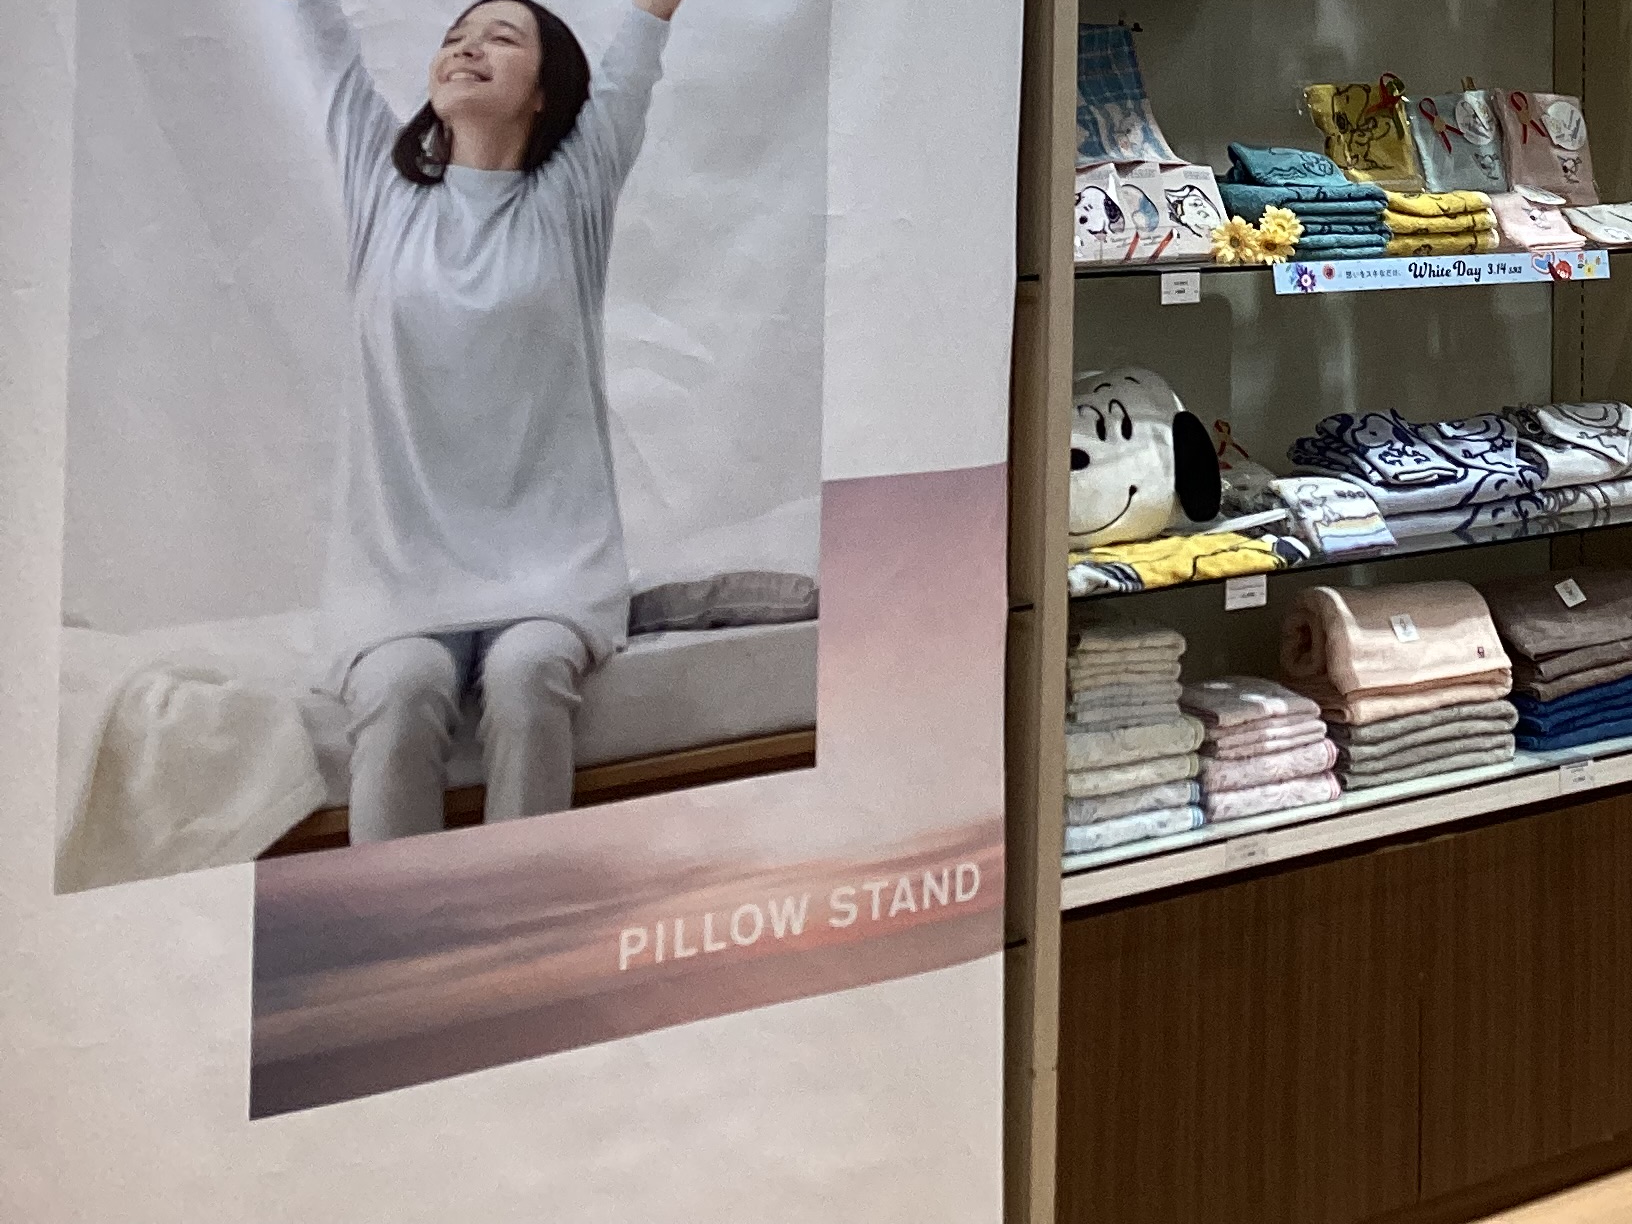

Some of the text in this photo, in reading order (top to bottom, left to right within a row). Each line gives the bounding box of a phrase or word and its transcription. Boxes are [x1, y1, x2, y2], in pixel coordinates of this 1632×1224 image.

[1408, 262, 1452, 279] White
[1452, 260, 1482, 283] Day
[1487, 263, 1507, 275] 3.14
[618, 860, 982, 971] PILLOW STAND
